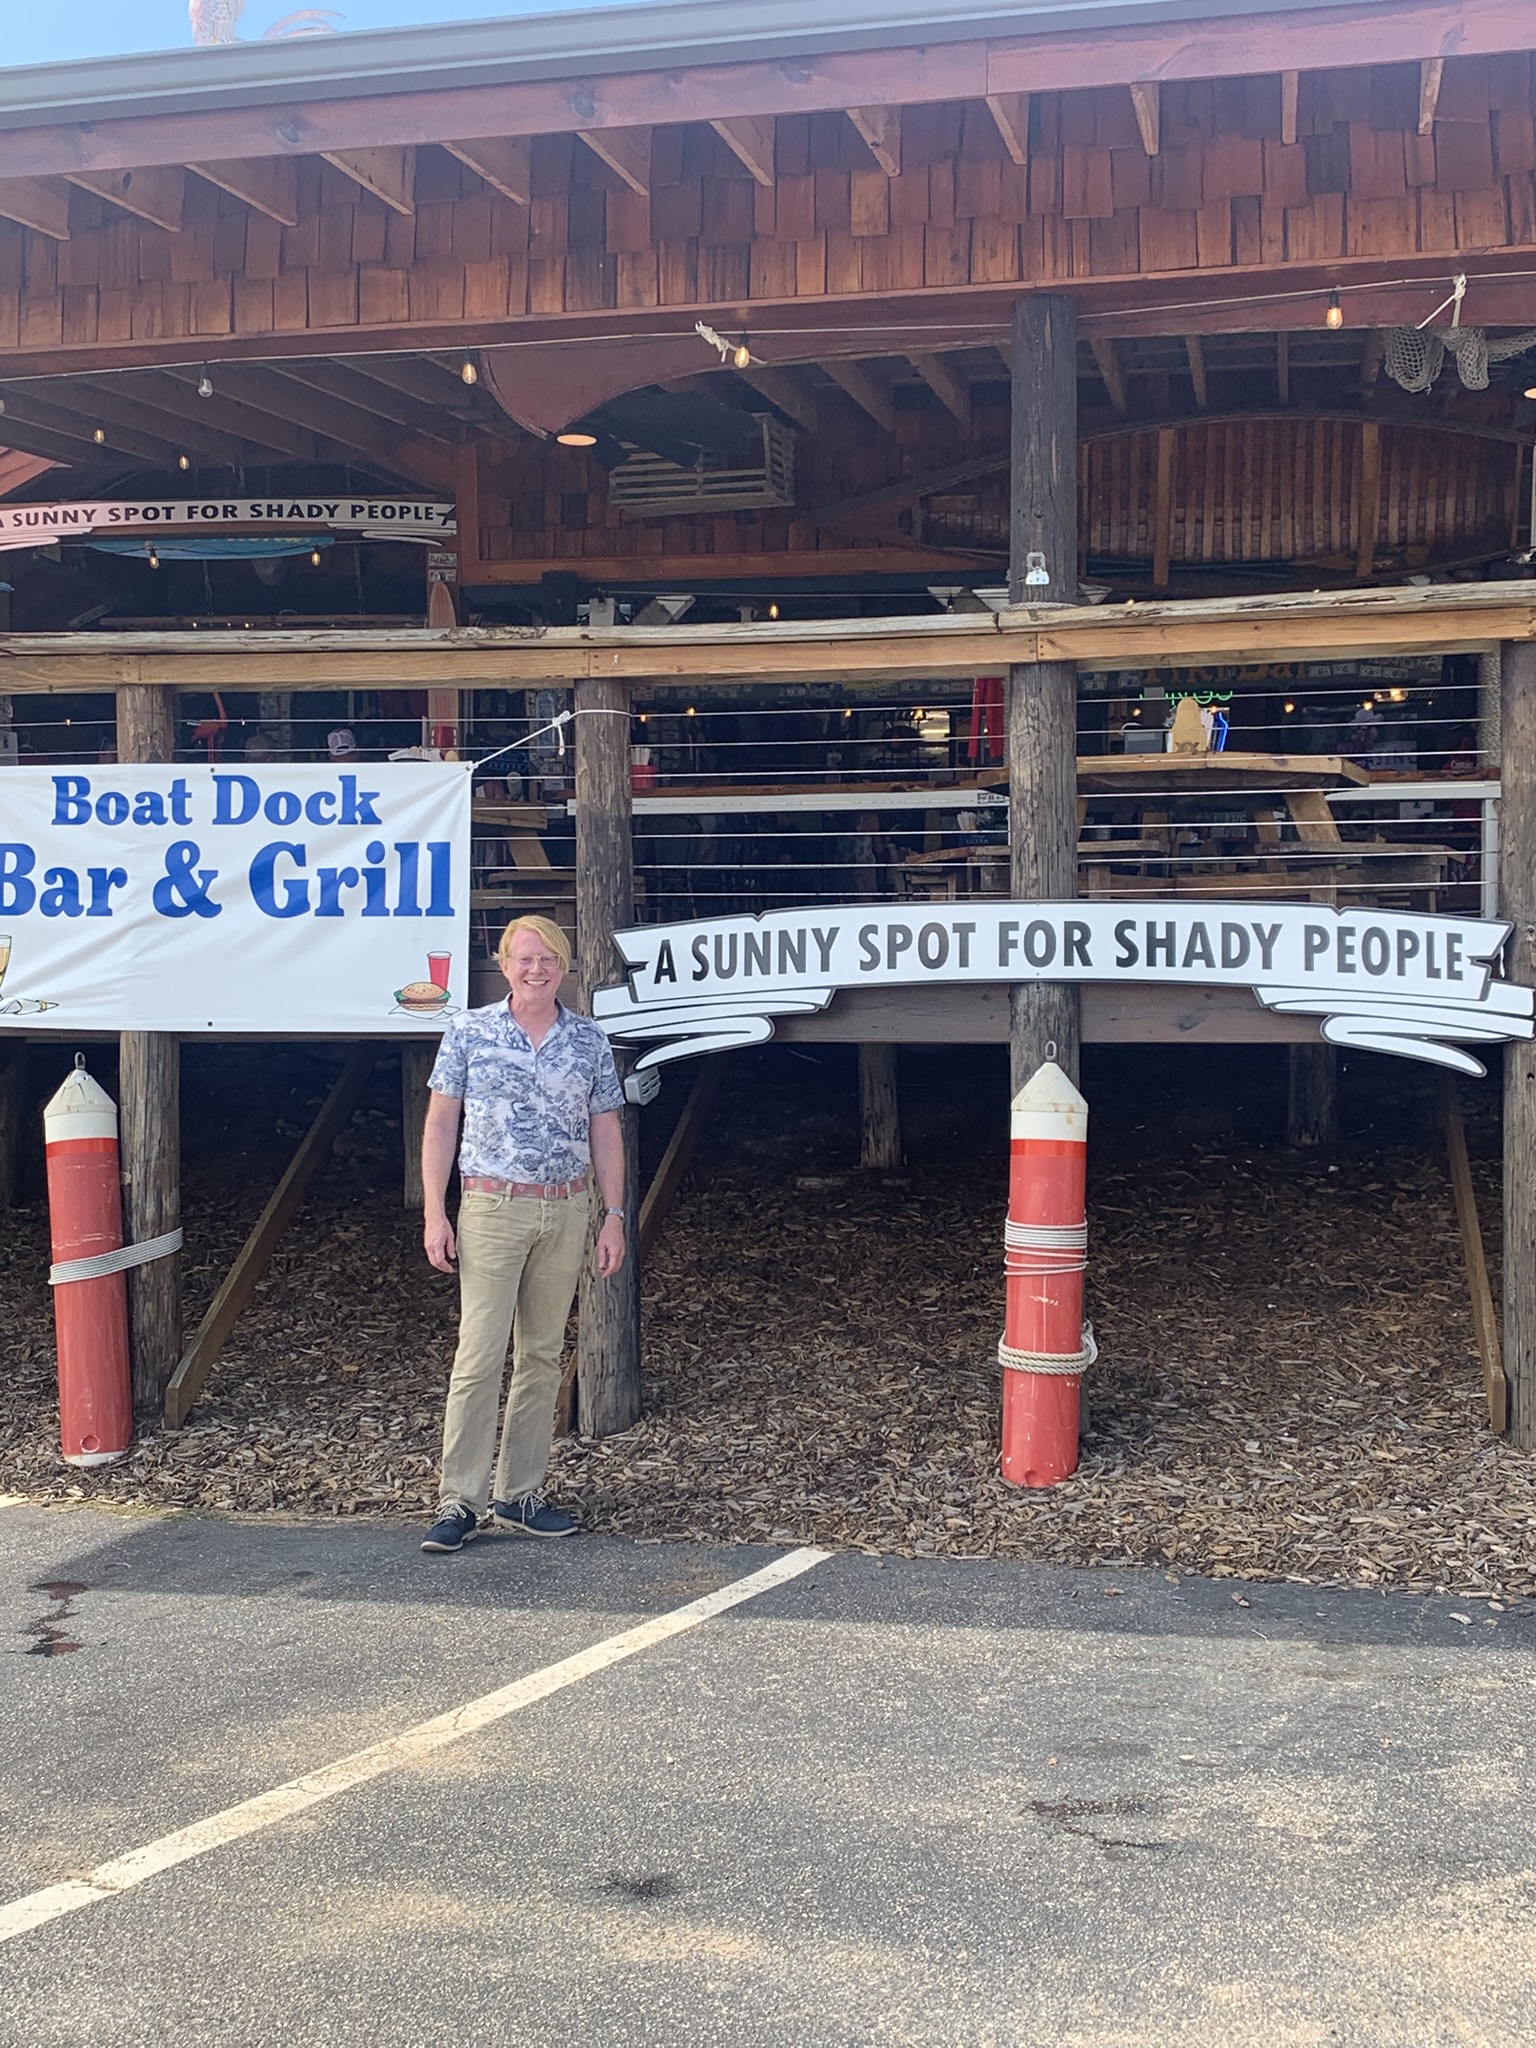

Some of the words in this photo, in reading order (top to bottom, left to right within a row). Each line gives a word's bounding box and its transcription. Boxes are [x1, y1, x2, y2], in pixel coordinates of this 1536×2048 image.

[12, 508, 98, 527] SUNNY
[107, 506, 176, 522] SPOT
[186, 504, 239, 521] FOR
[249, 503, 341, 519] SHADY
[350, 503, 435, 521] PEOPLE
[51, 774, 193, 827] Boat
[211, 773, 383, 827] Dock
[0, 841, 129, 918] Bar
[151, 839, 223, 920] &
[247, 839, 456, 920] Grill
[653, 938, 678, 985] A
[691, 926, 841, 982] SUNNY
[858, 921, 976, 972] SPOT
[998, 919, 1094, 968] FOR
[1114, 919, 1284, 970] SHADY
[1304, 923, 1465, 981] PEOPLE
